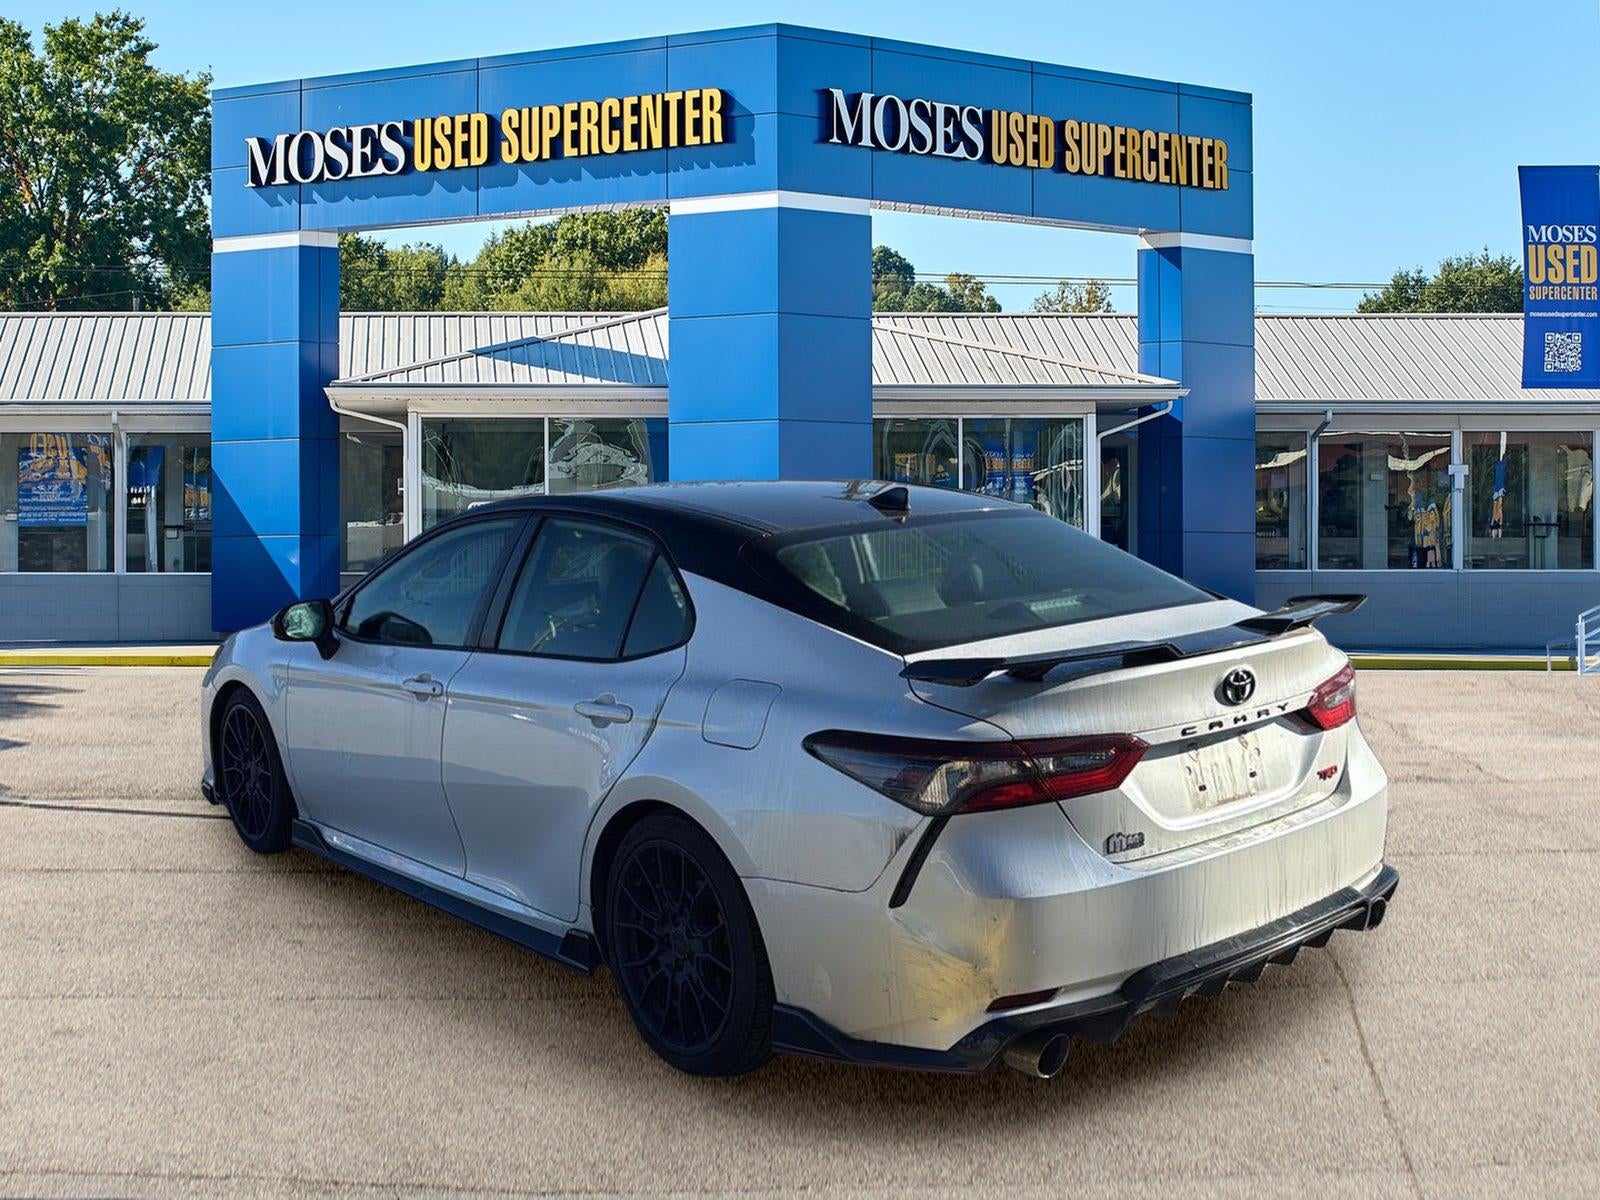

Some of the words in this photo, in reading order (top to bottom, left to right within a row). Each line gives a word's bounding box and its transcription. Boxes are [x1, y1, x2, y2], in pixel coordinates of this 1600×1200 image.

[244, 120, 407, 188] MOSES
[412, 112, 489, 172] USED
[501, 87, 725, 164] SUPERCENTER
[828, 87, 985, 161] MOSES
[991, 109, 1056, 169] USED
[1065, 119, 1229, 190] SUPERCENTER
[1527, 225, 1597, 243] MOSES
[1527, 244, 1598, 284] USED
[1529, 286, 1598, 301] SUPERCENTER
[1181, 702, 1289, 737] CAMRY
